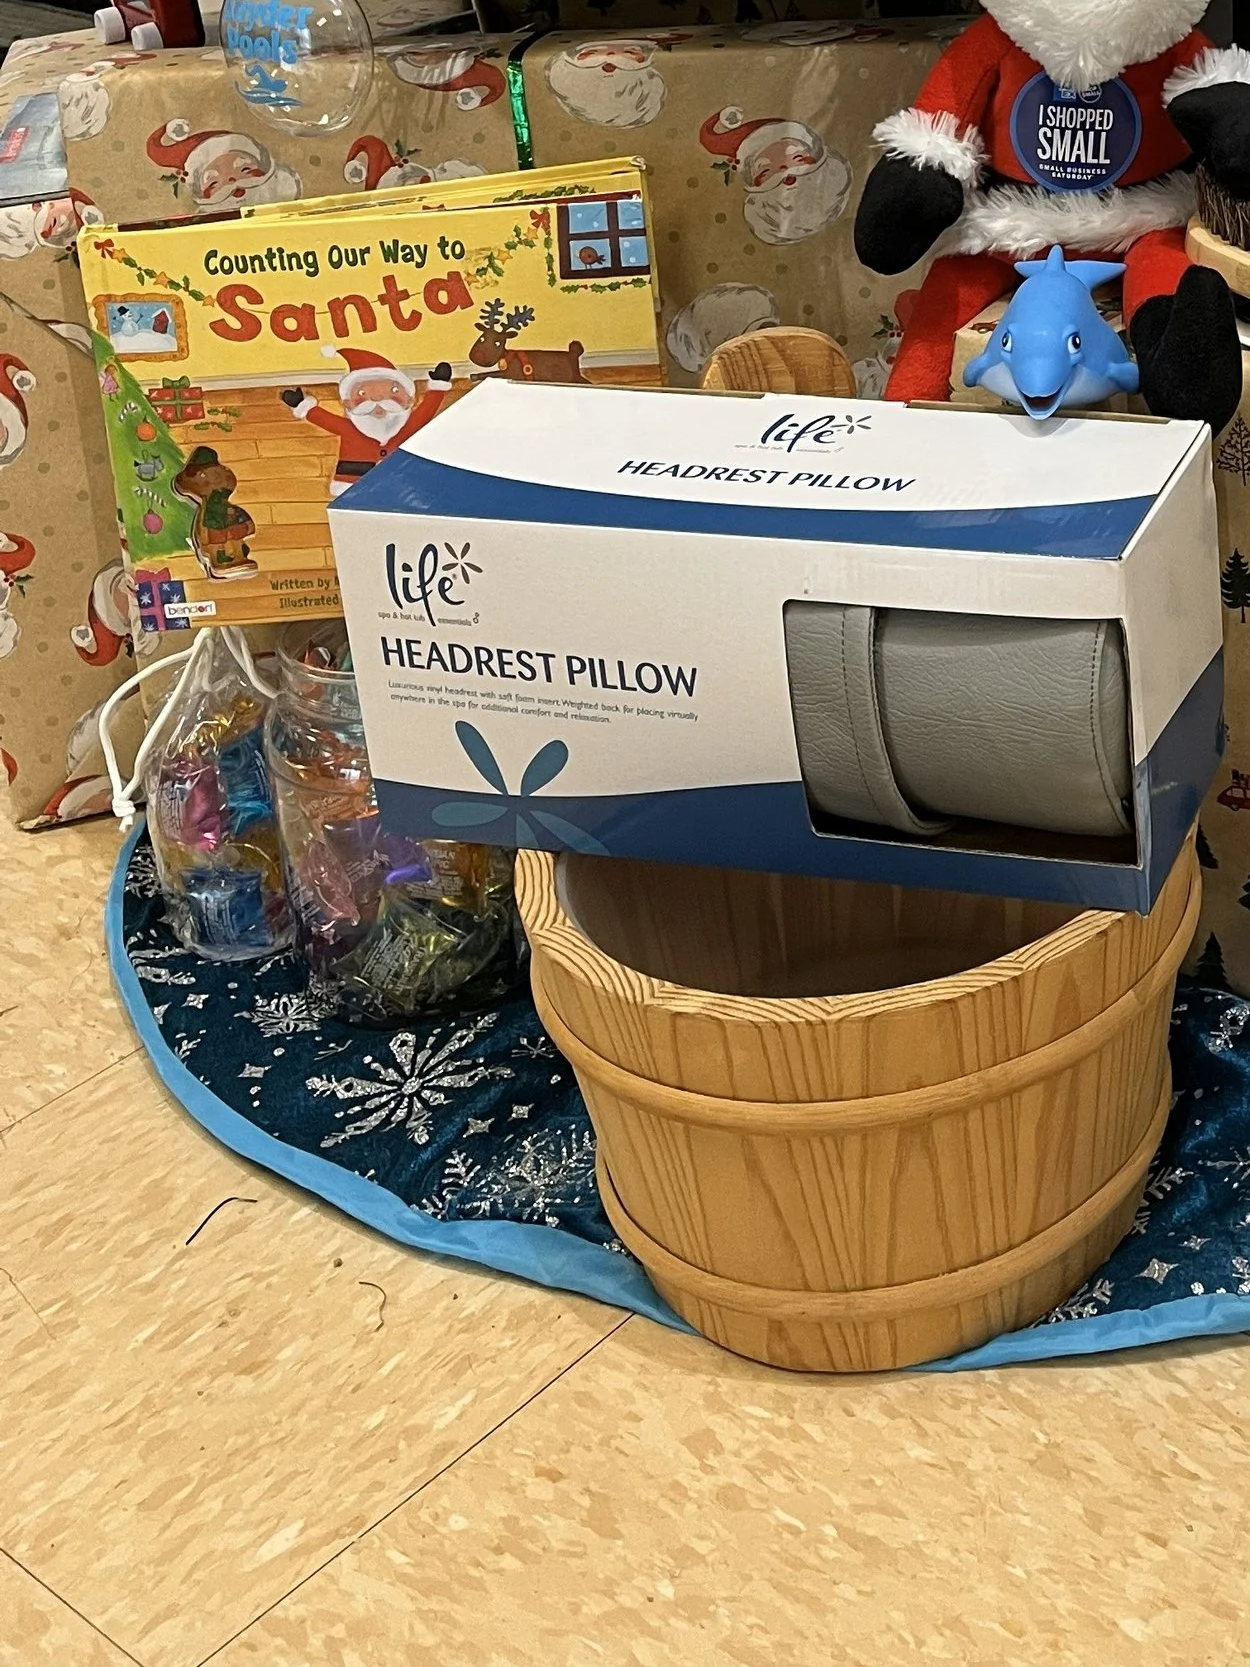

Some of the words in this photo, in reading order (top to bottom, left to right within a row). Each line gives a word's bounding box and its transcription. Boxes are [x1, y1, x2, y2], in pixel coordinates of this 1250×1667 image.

[1038, 104, 1044, 125] I
[1046, 105, 1114, 131] SHOPPED
[1037, 127, 1111, 165] SMALL
[1039, 163, 1064, 172] SMALL
[1066, 167, 1107, 175] BUSINESS
[1051, 172, 1092, 180] SATURDAY
[204, 246, 320, 277] Counting
[327, 244, 370, 269] Our
[379, 239, 428, 268] Way
[437, 235, 465, 260] to
[208, 271, 474, 342] Santa
[617, 460, 788, 484] HEADREST
[788, 472, 917, 492] PILLOW
[279, 594, 339, 609] Illustrated
[385, 543, 466, 627] life
[380, 636, 556, 683] HEADREST
[566, 655, 697, 697] PILLOW
